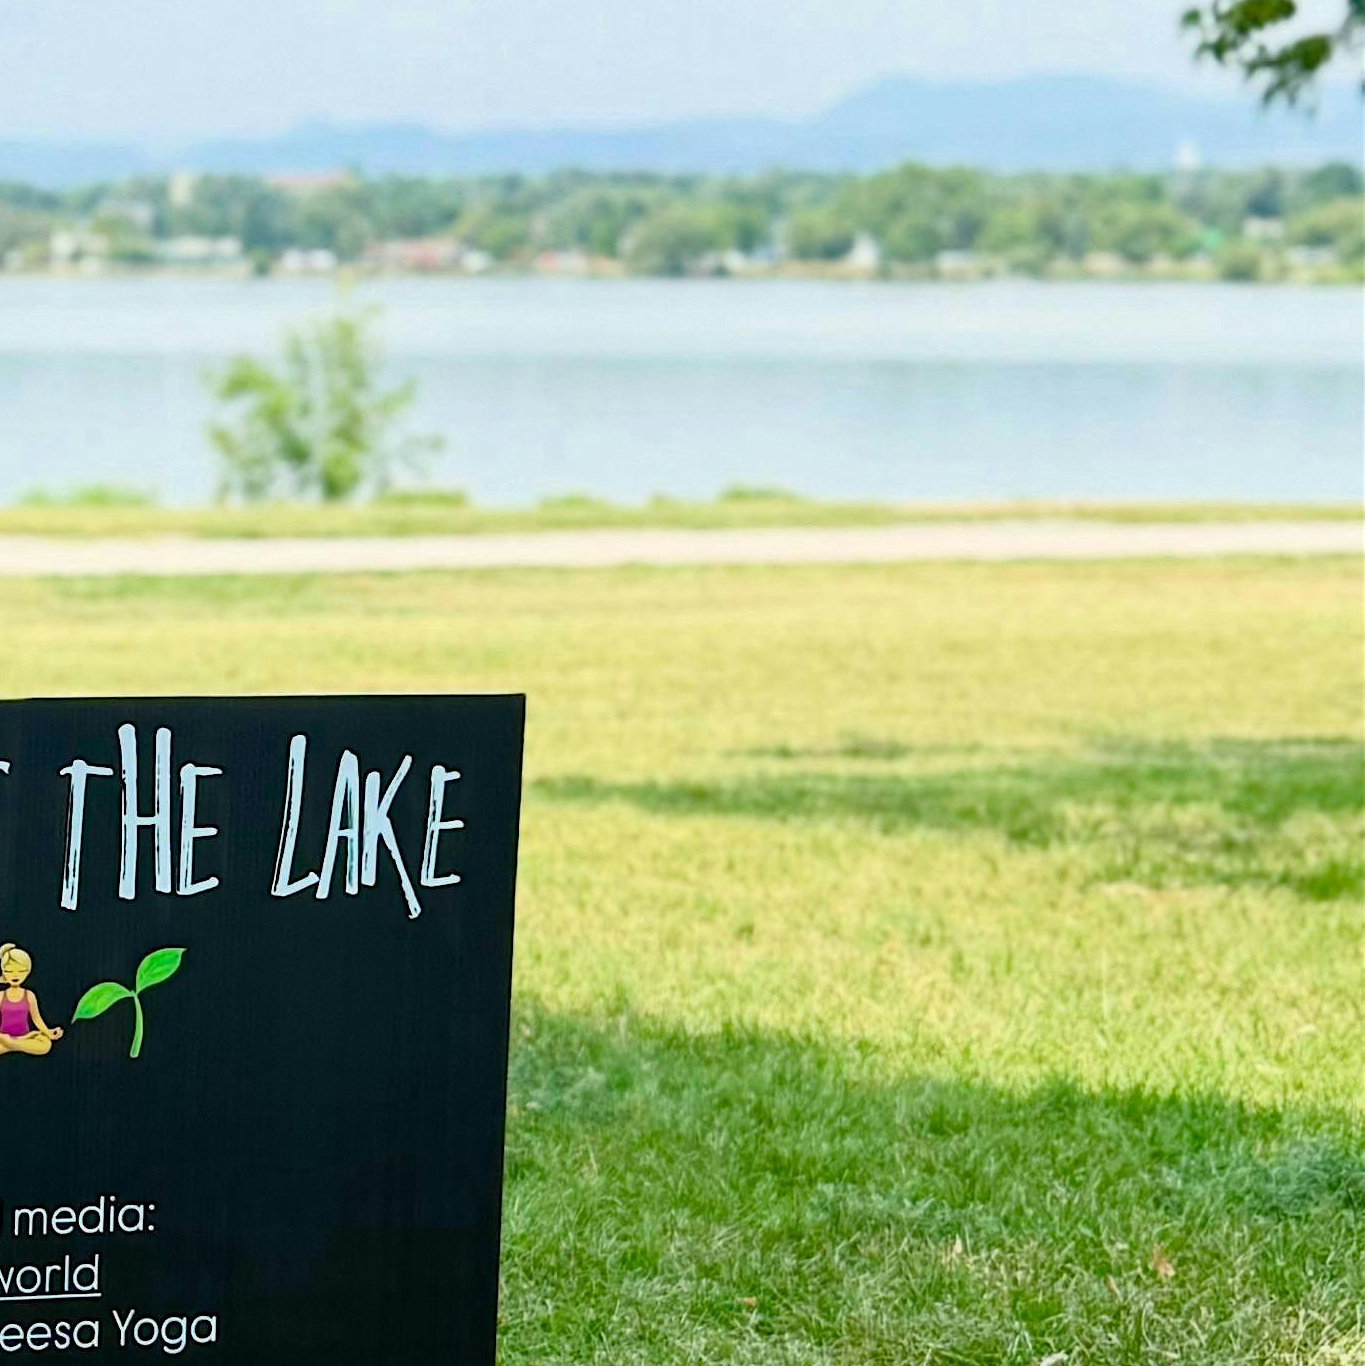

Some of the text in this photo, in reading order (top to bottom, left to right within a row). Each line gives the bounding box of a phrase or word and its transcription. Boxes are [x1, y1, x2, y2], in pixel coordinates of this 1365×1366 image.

[60, 724, 222, 910] THE
[271, 735, 464, 919] LAKE
[15, 1196, 154, 1235] media:
[113, 1309, 216, 1354] Yoga
